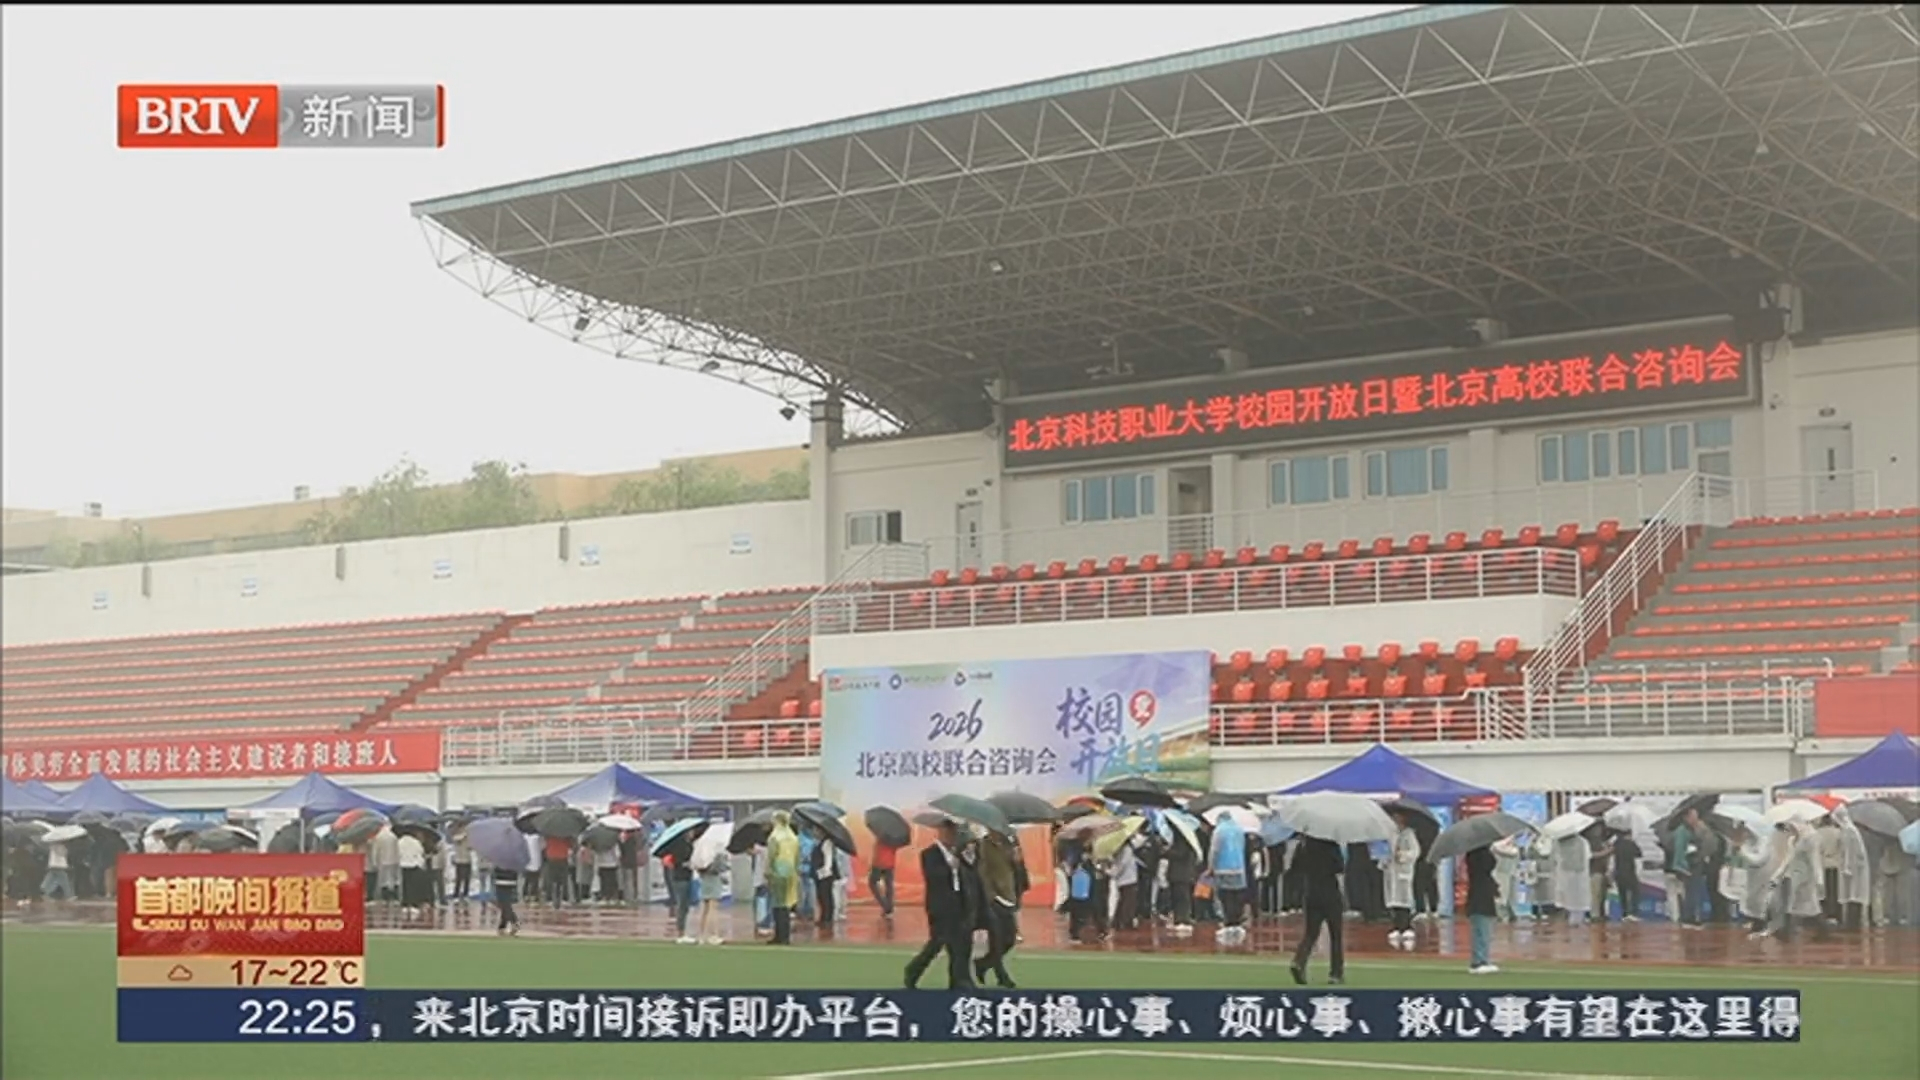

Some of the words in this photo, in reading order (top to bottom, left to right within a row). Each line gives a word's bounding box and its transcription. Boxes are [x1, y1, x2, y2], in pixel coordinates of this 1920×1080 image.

[1008, 340, 1742, 453] 北京科技职业大学校园开放日暨北京高校联合咨询会
[927, 699, 984, 741] 2026
[1056, 687, 1124, 739] 校园
[855, 748, 1058, 778] 北京高校联合咨询会
[1070, 734, 1161, 786] 开放日
